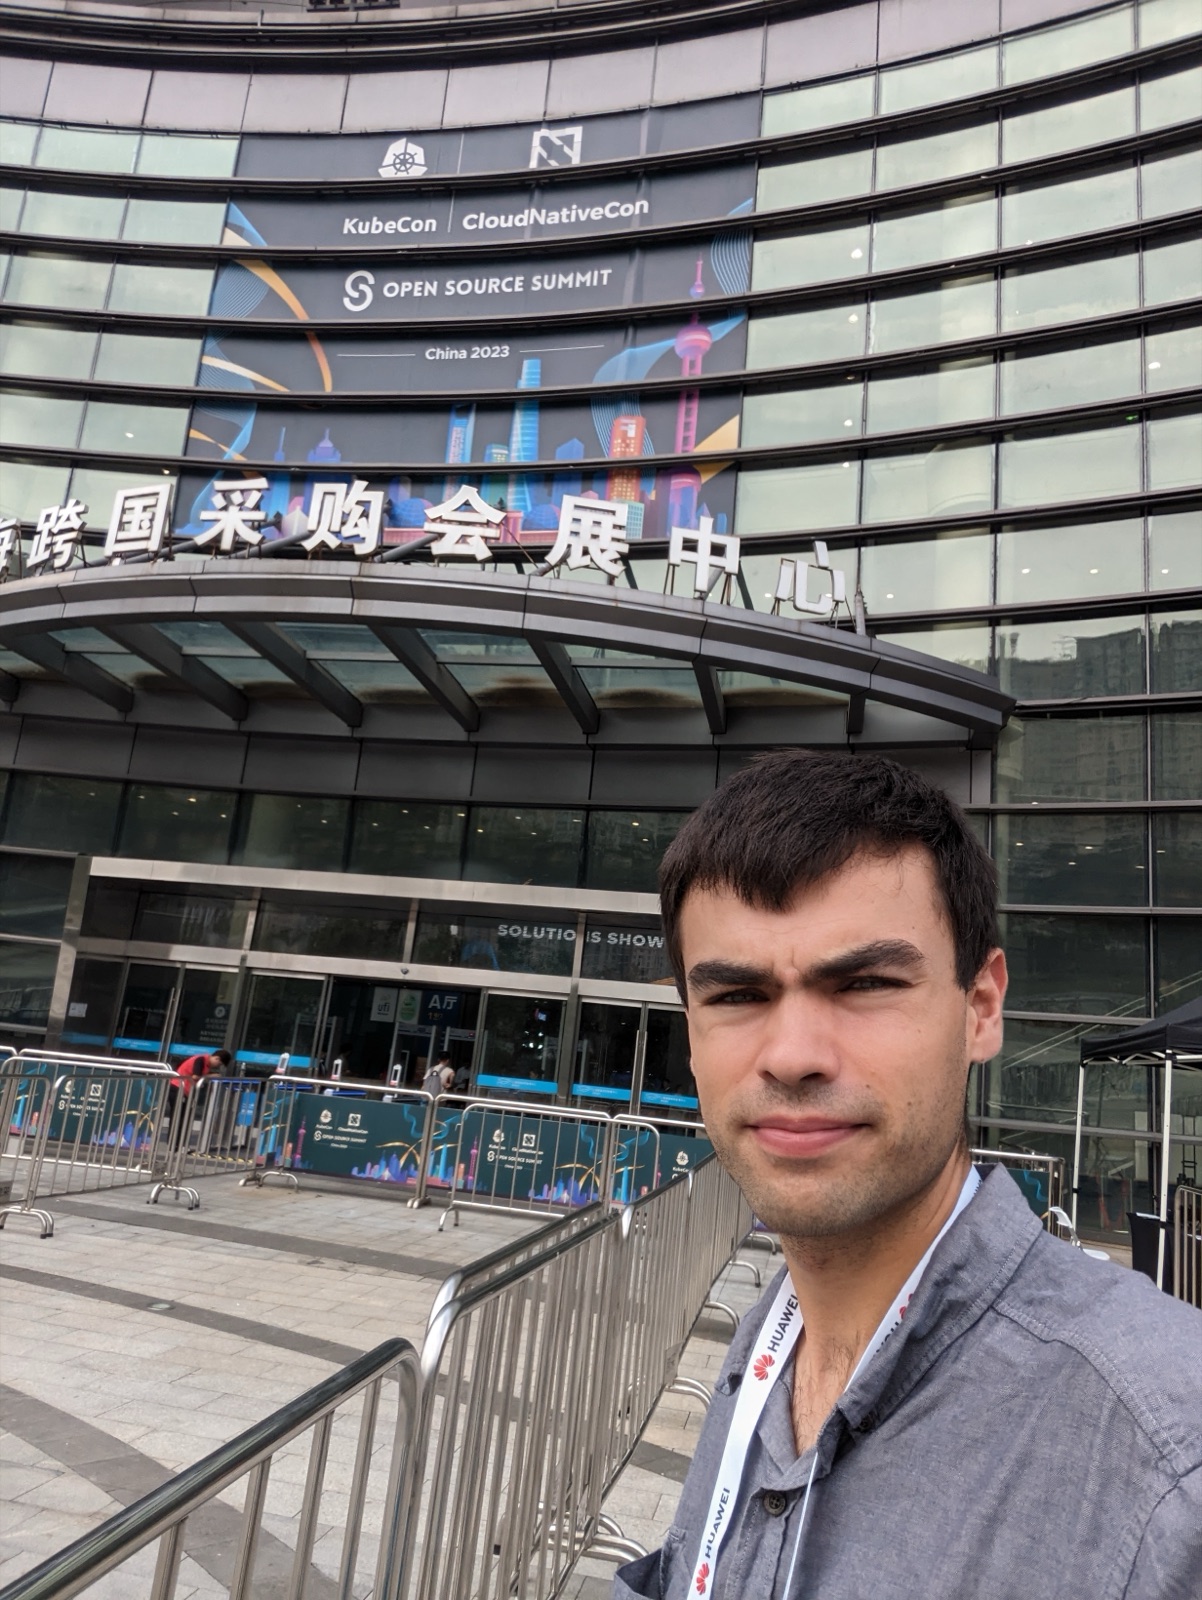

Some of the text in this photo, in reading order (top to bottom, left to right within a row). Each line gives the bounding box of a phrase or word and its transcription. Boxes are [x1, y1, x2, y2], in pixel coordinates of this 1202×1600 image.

[343, 199, 650, 234] KubeCon CloudNativeCon
[383, 269, 613, 298] OPEN SOURCE SUMMIT
[425, 345, 510, 361] China 2023
[498, 924, 602, 943] SOLUTIOS
[427, 994, 458, 1010] A厅
[767, 1294, 799, 1353] HUAWEI
[704, 1487, 731, 1559] HUAWEI
